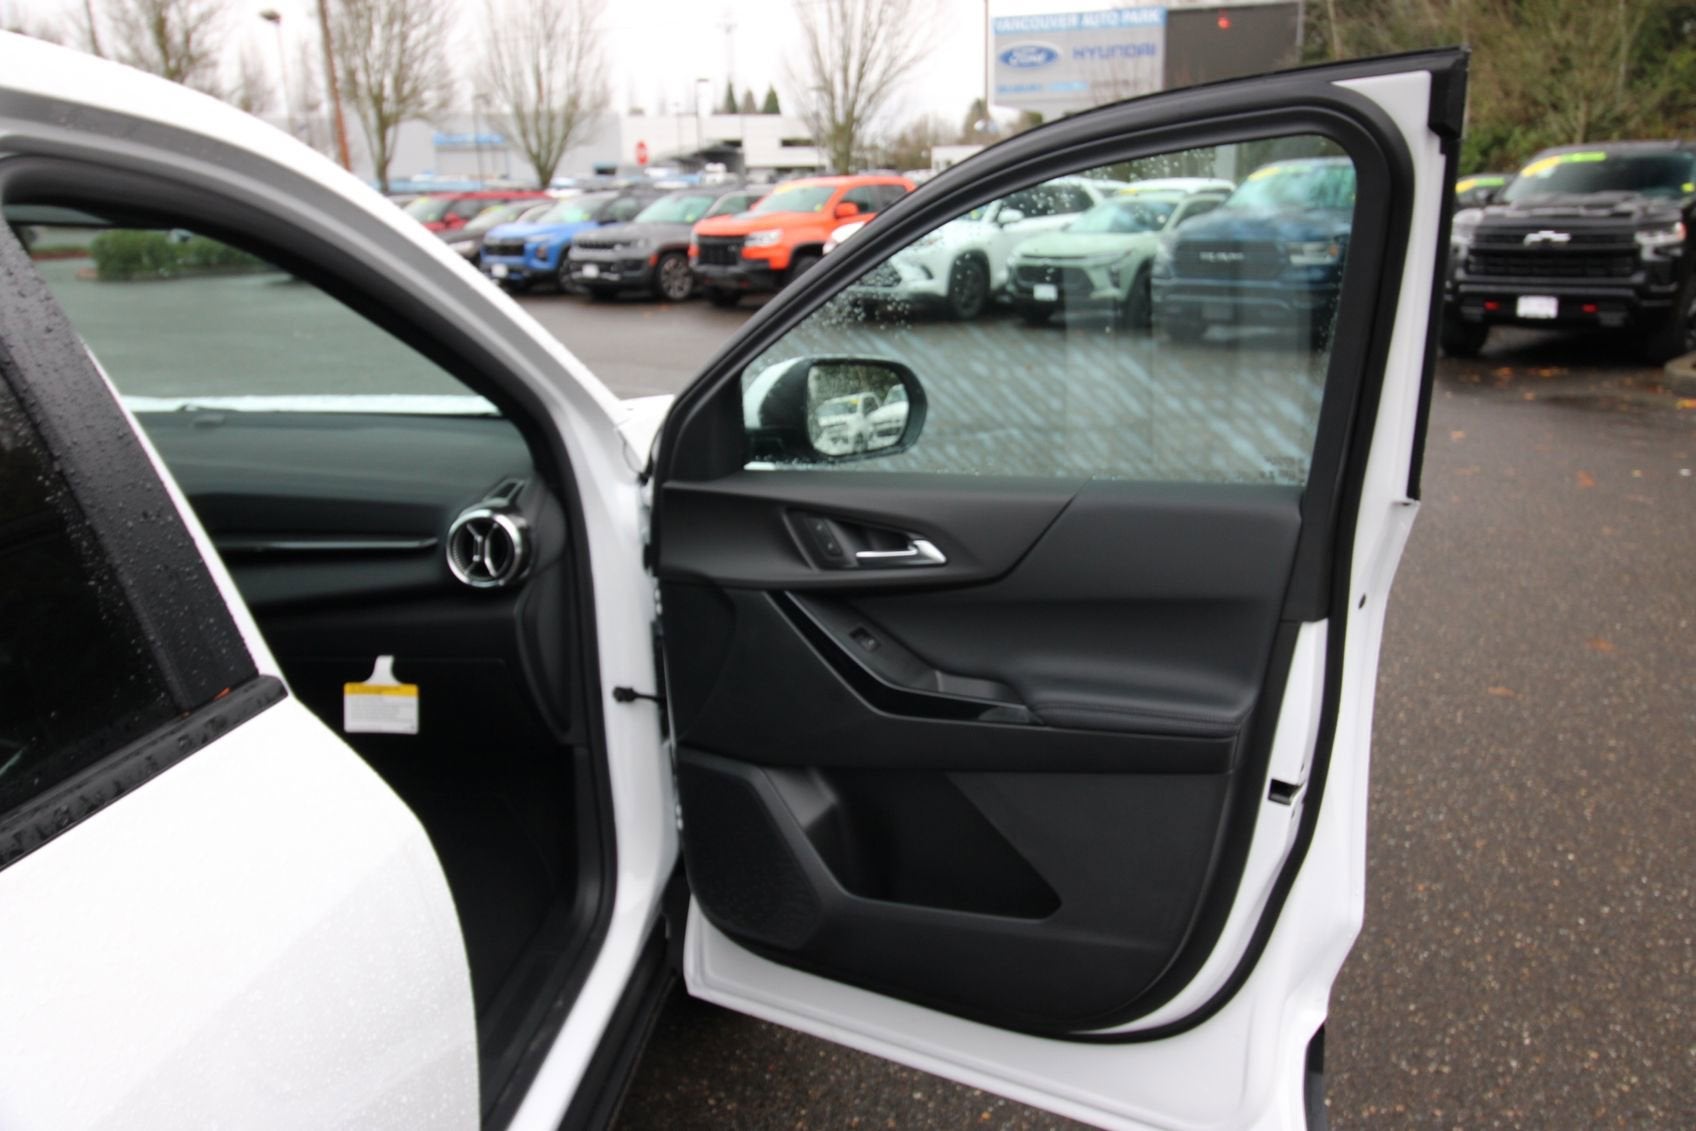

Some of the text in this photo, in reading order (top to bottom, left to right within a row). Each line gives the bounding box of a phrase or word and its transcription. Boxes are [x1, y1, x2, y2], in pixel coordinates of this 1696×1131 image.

[994, 8, 1160, 31] VANCOUVER AUTO PARK
[1007, 48, 1048, 65] Ford
[1072, 43, 1156, 59] HYUNDAI
